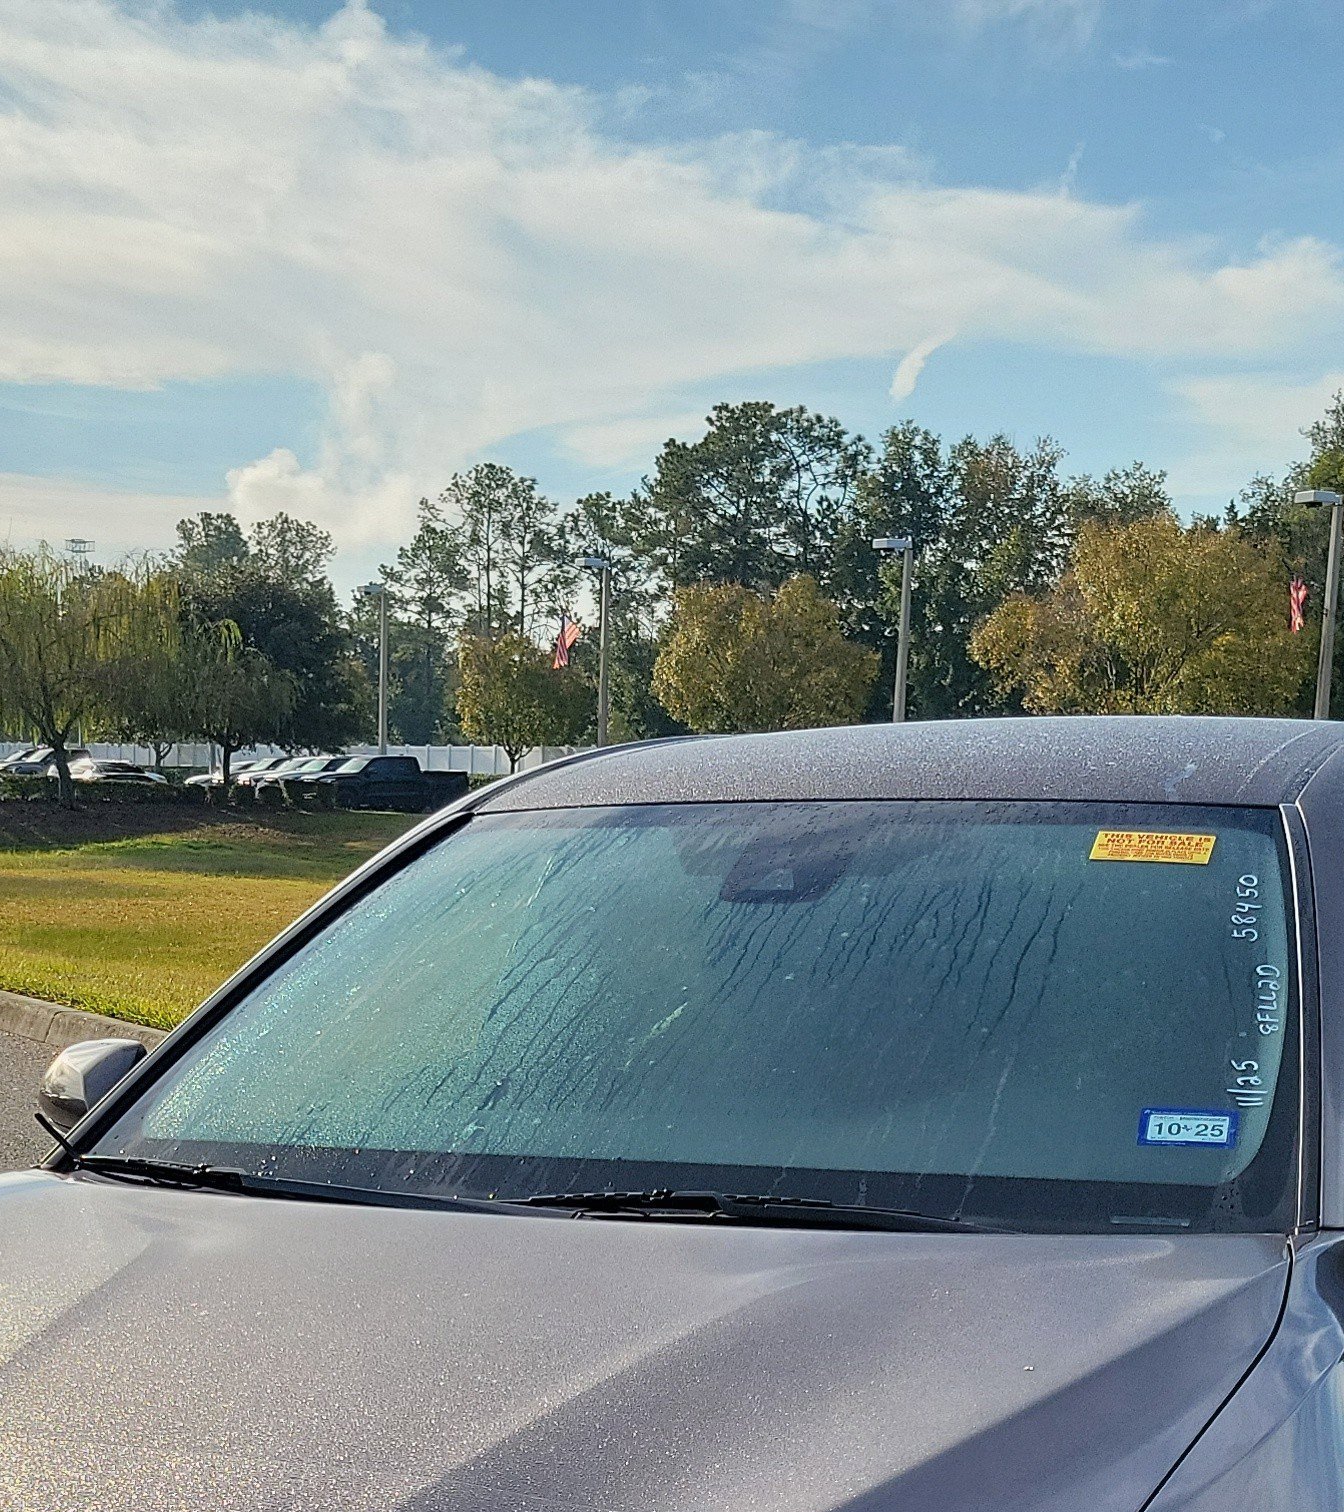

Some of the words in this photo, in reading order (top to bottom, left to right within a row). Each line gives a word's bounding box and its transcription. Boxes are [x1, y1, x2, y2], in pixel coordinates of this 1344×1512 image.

[1137, 834, 1194, 842] VEHICLE
[1231, 874, 1262, 942] 58450
[1226, 1059, 1268, 1106] 11/25
[1154, 1122, 1181, 1136] 10
[1194, 1123, 1224, 1137] 25
